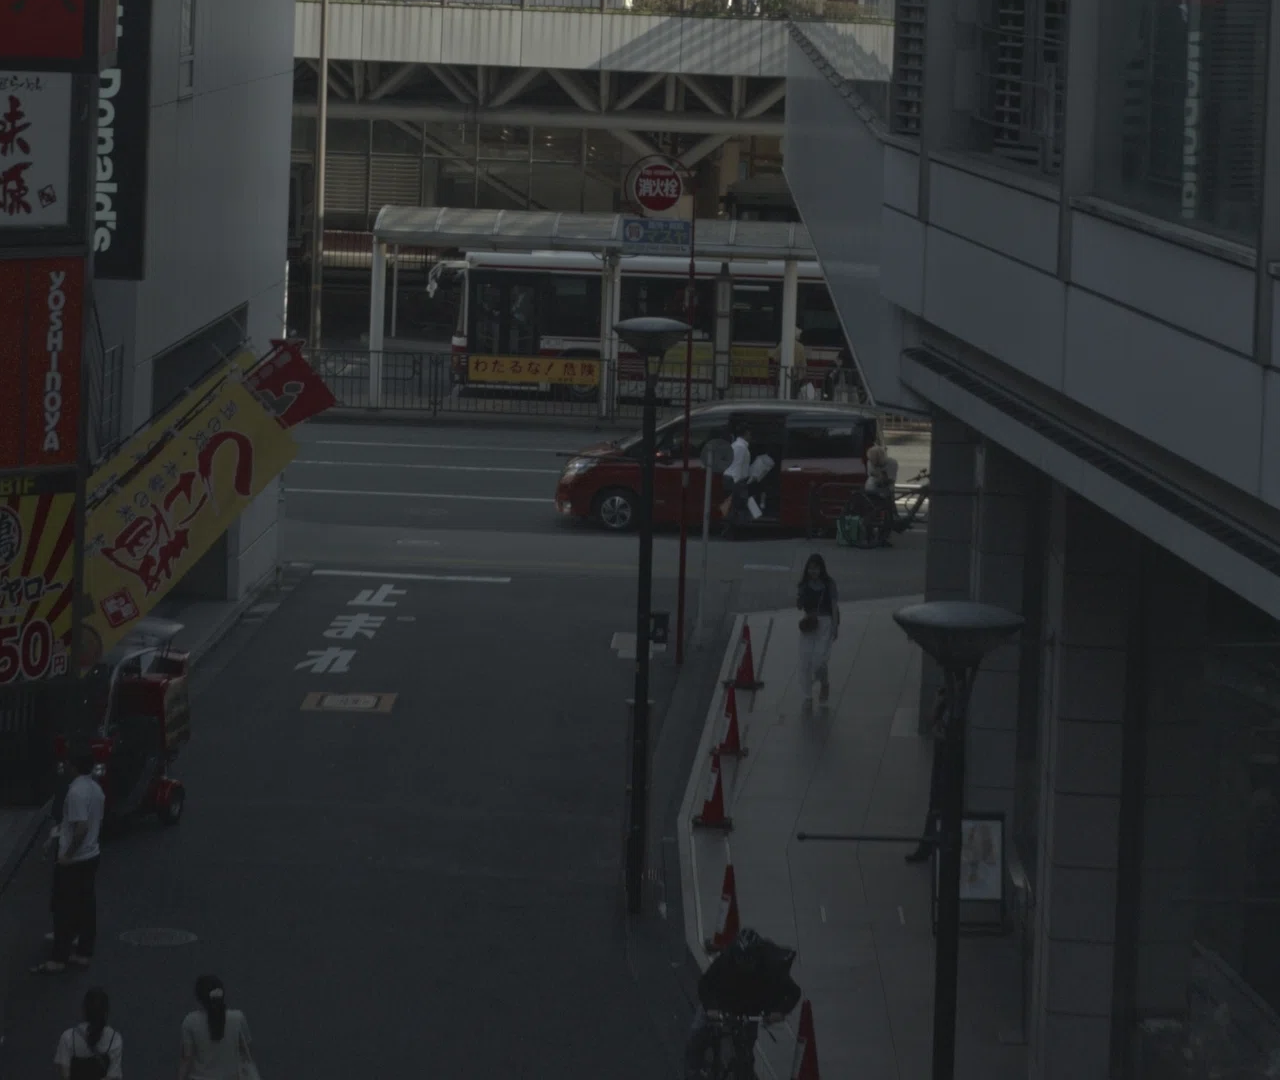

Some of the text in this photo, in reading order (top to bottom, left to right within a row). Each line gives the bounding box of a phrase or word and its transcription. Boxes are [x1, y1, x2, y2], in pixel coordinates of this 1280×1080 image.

[94, 4, 124, 252] Donald's
[638, 178, 678, 198] 消火栓
[293, 584, 408, 674] 止まれ
